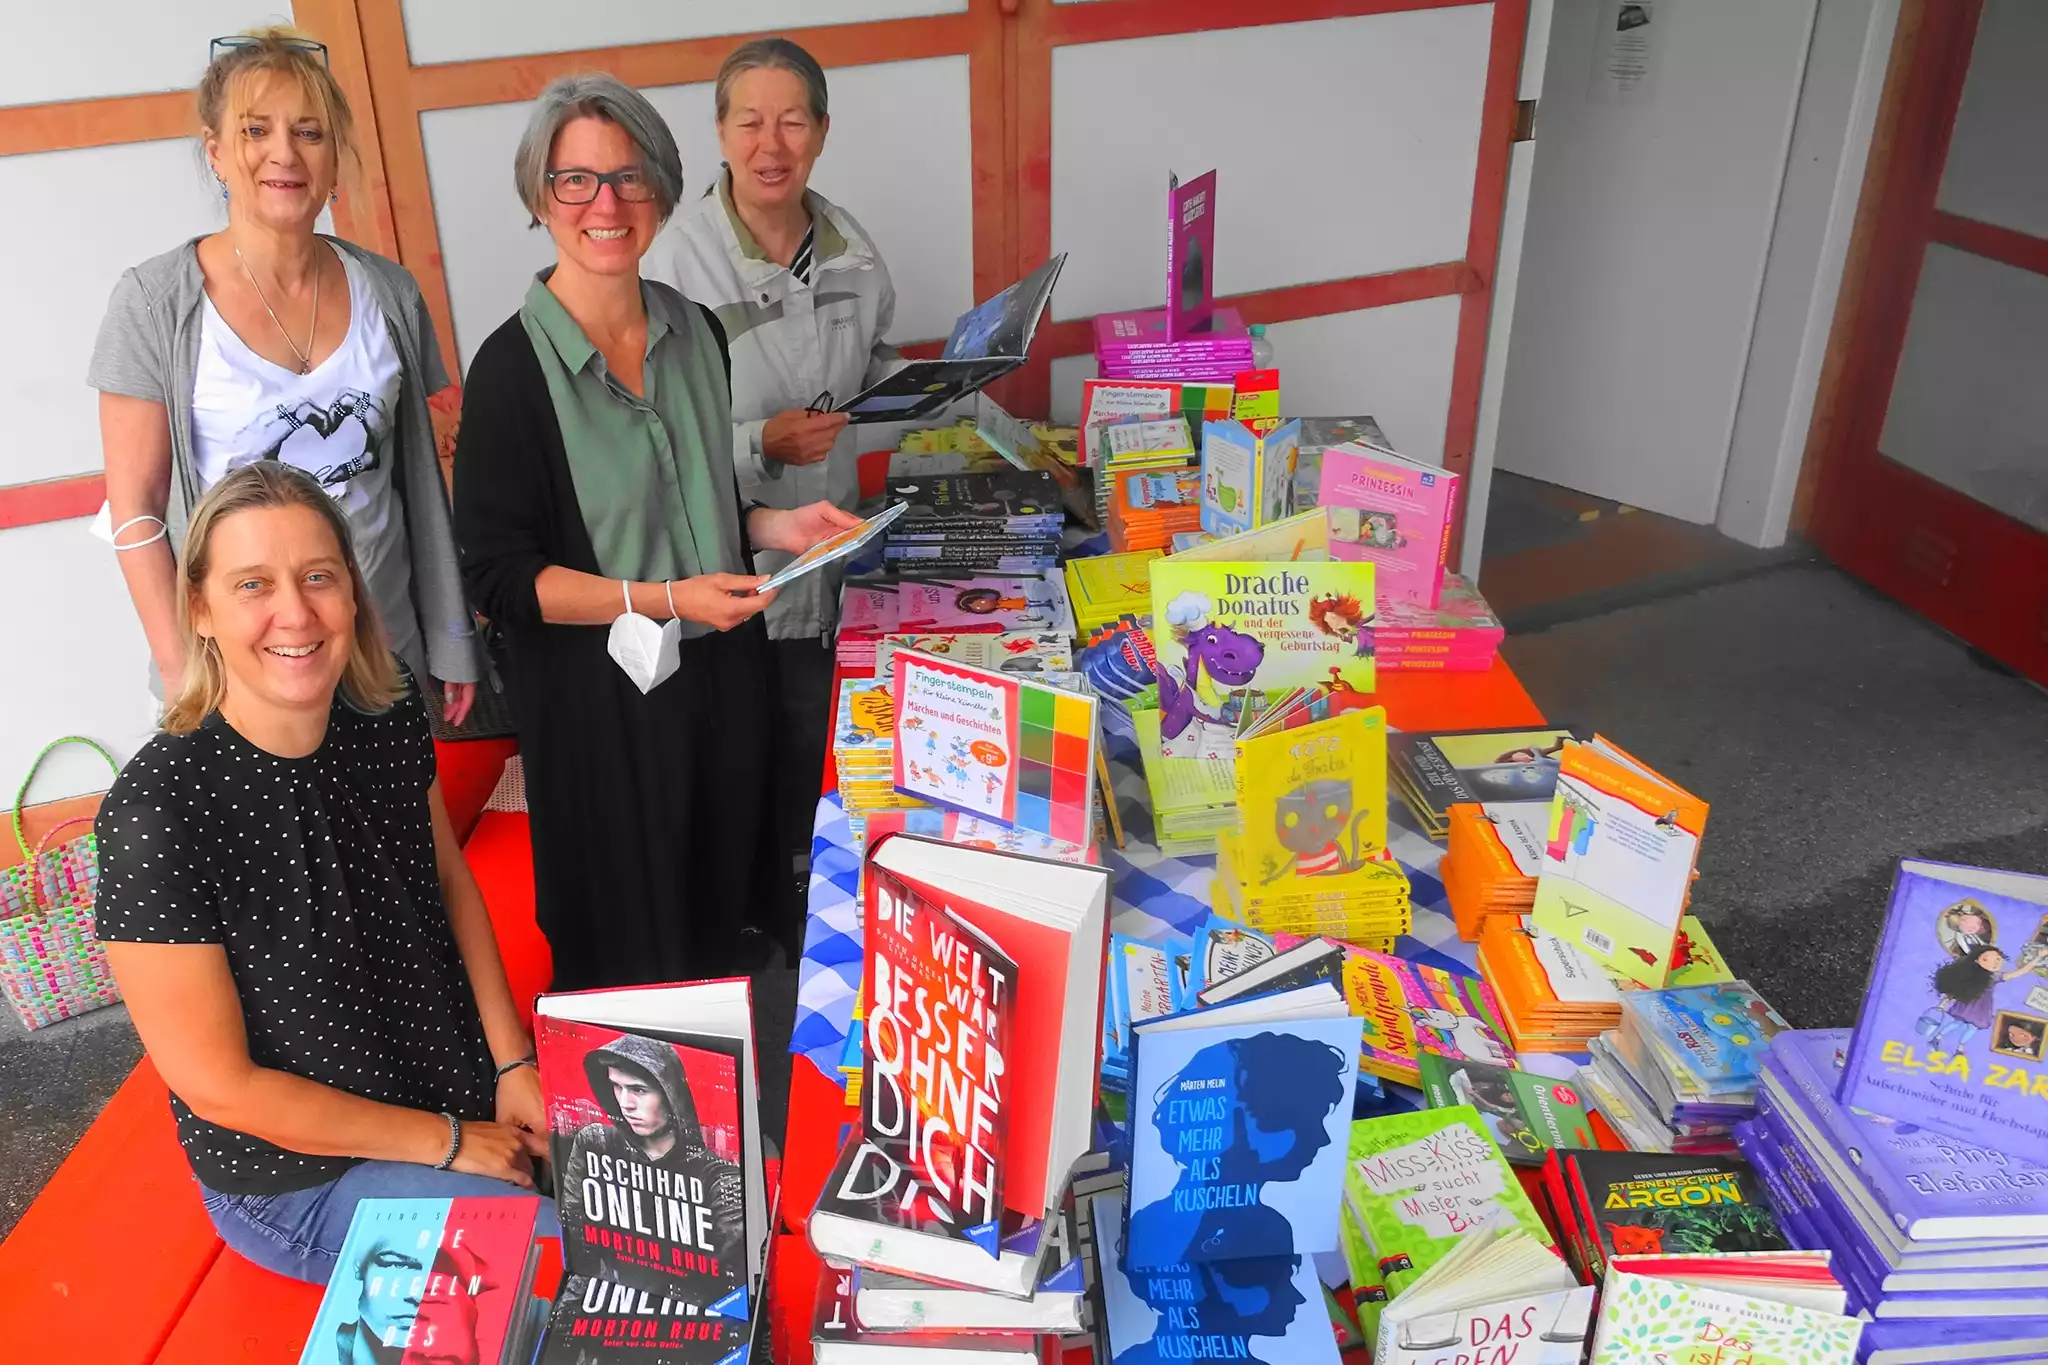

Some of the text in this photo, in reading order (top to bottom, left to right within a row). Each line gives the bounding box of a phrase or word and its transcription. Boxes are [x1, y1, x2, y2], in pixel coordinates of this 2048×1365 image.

[1351, 473, 1414, 498] PRINZESSIN
[1225, 571, 1310, 596] Drache
[1217, 598, 1300, 616] Donatus
[1244, 618, 1283, 629] und der
[1258, 630, 1315, 641] vergessene
[1280, 641, 1341, 654] Geburtstag
[914, 671, 994, 701] Fingerstempeln
[907, 701, 1002, 736] Märchen und Geschichten
[876, 927, 908, 955] SARAH
[877, 886, 1005, 1006] DIE WELT
[1217, 949, 1240, 982] MEINE
[1141, 989, 1151, 1013] Meine
[1358, 961, 1408, 1055] Schulfreunde
[874, 952, 1006, 1102] BESSER
[1880, 1040, 1970, 1084] ELSA
[868, 1005, 999, 1163] OHNE
[1207, 1078, 1226, 1090] MELIN
[1865, 1075, 1947, 1107] Aufschneider
[1950, 1102, 1976, 1116] und
[1929, 1079, 2000, 1108] Schule für
[1168, 1096, 1227, 1124] ETWAS
[872, 1060, 995, 1224] DICH
[1178, 1127, 1222, 1155] MEHR
[1937, 1140, 2010, 1167] Ping
[586, 1150, 703, 1204] DSCHIHAD
[1189, 1157, 1221, 1181] ALS
[1906, 1168, 2048, 1195] Elefanten
[1433, 1173, 1482, 1191] sucht
[1608, 1173, 1735, 1191] STERNENSCHIFF
[1173, 1184, 1258, 1213] KUSCHELN
[1403, 1194, 1461, 1218] Mister
[1604, 1184, 1742, 1209] ARGON
[376, 1212, 418, 1221] TINO
[582, 1178, 715, 1252] ONLINE
[417, 1229, 465, 1250] DIE
[585, 1224, 720, 1277] MORTON RHUE
[616, 1252, 634, 1264] Autor
[636, 1258, 649, 1267] von
[369, 1275, 482, 1297] REGELN
[1043, 1262, 1076, 1287] Ravensburger
[714, 1291, 742, 1311] Ravensburger
[1149, 1279, 1194, 1300] MEHR
[572, 1318, 724, 1341] MORTON RHUE
[1168, 1306, 1199, 1330] ALS
[1470, 1306, 1537, 1347] DAS
[382, 1324, 438, 1347] DES
[603, 1338, 623, 1347] Autor
[625, 1340, 639, 1348] von
[1156, 1335, 1248, 1360] KUSCHELN
[1697, 1321, 1753, 1352] Das
